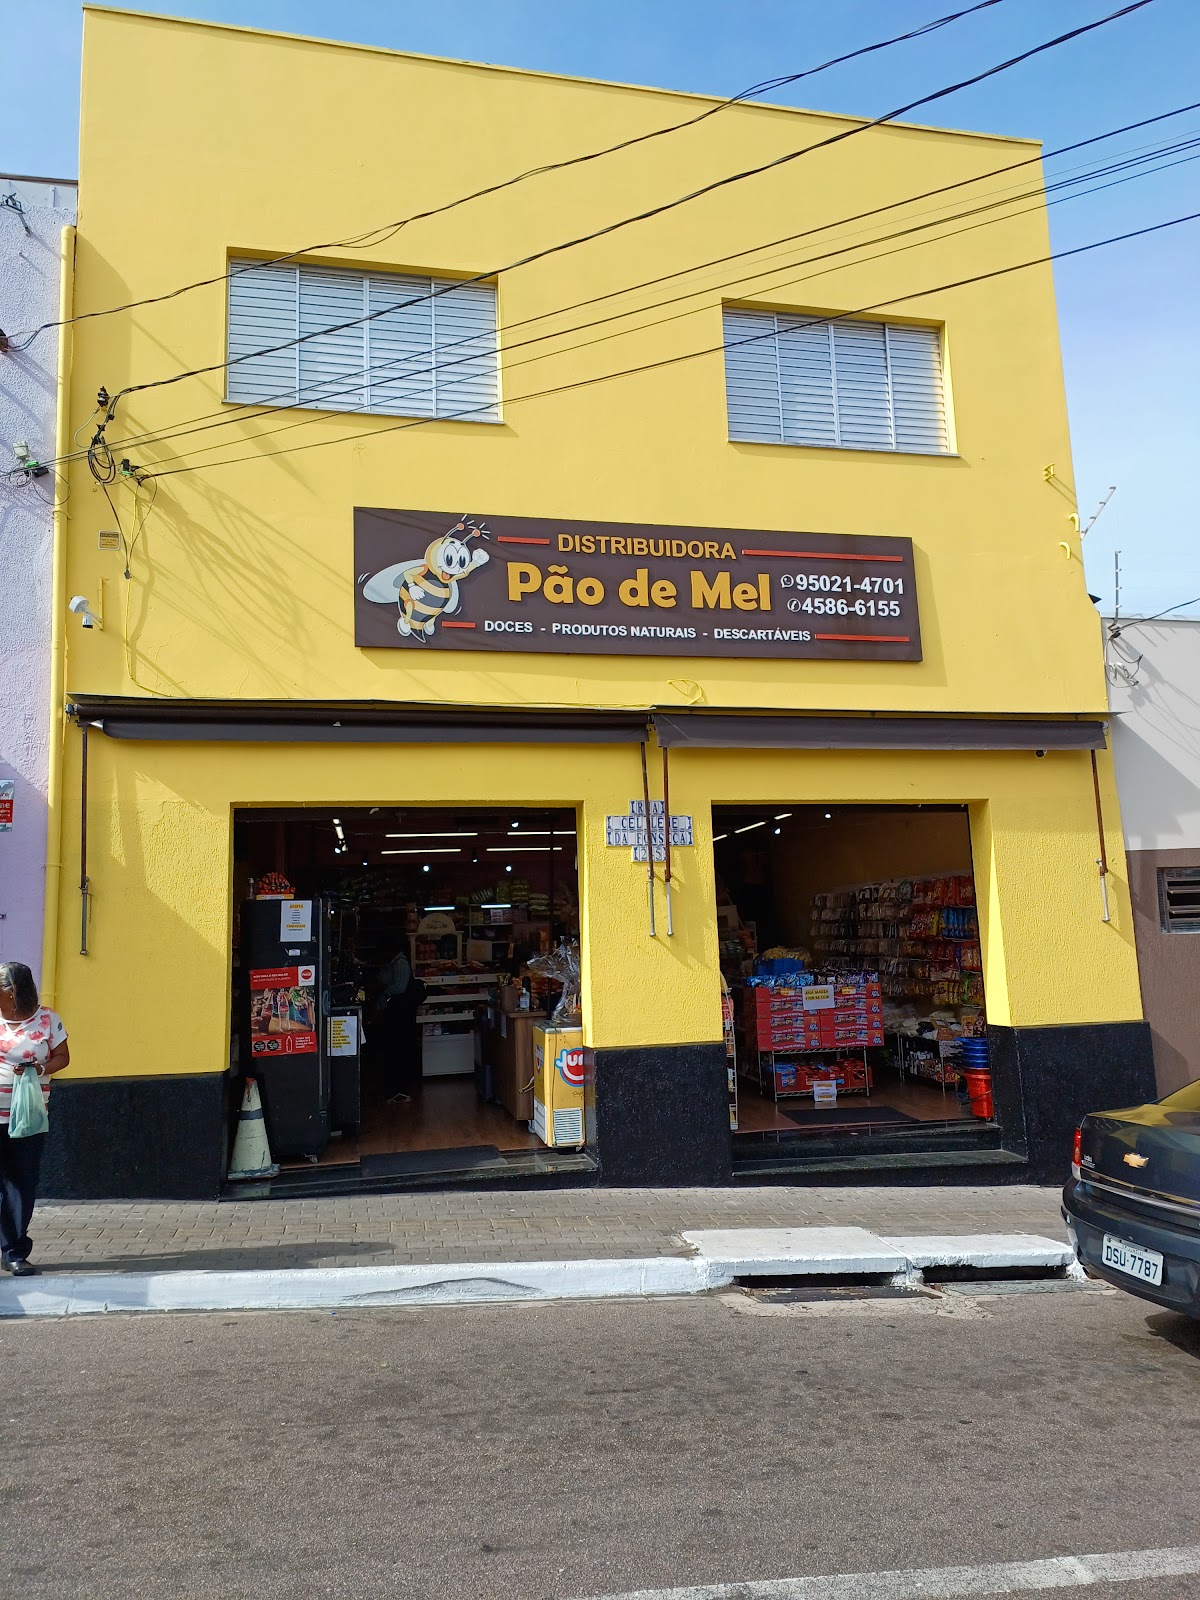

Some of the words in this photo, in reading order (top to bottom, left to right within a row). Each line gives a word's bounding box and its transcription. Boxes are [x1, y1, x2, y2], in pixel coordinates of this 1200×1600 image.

[557, 533, 737, 560] DISTRIBUIDORA
[506, 561, 606, 606] Pão
[618, 568, 677, 608] de
[690, 570, 772, 611] Mel
[795, 573, 904, 595] 95021-4701
[801, 597, 901, 617] 4586-6155
[484, 620, 533, 634] DOCES
[551, 622, 628, 637] PRODUTOS
[630, 625, 697, 639] NATURAIS
[714, 627, 812, 642] DESCARTÁVEIS
[637, 802, 658, 814] RA
[651, 817, 678, 829] LEE
[614, 832, 628, 844] DA
